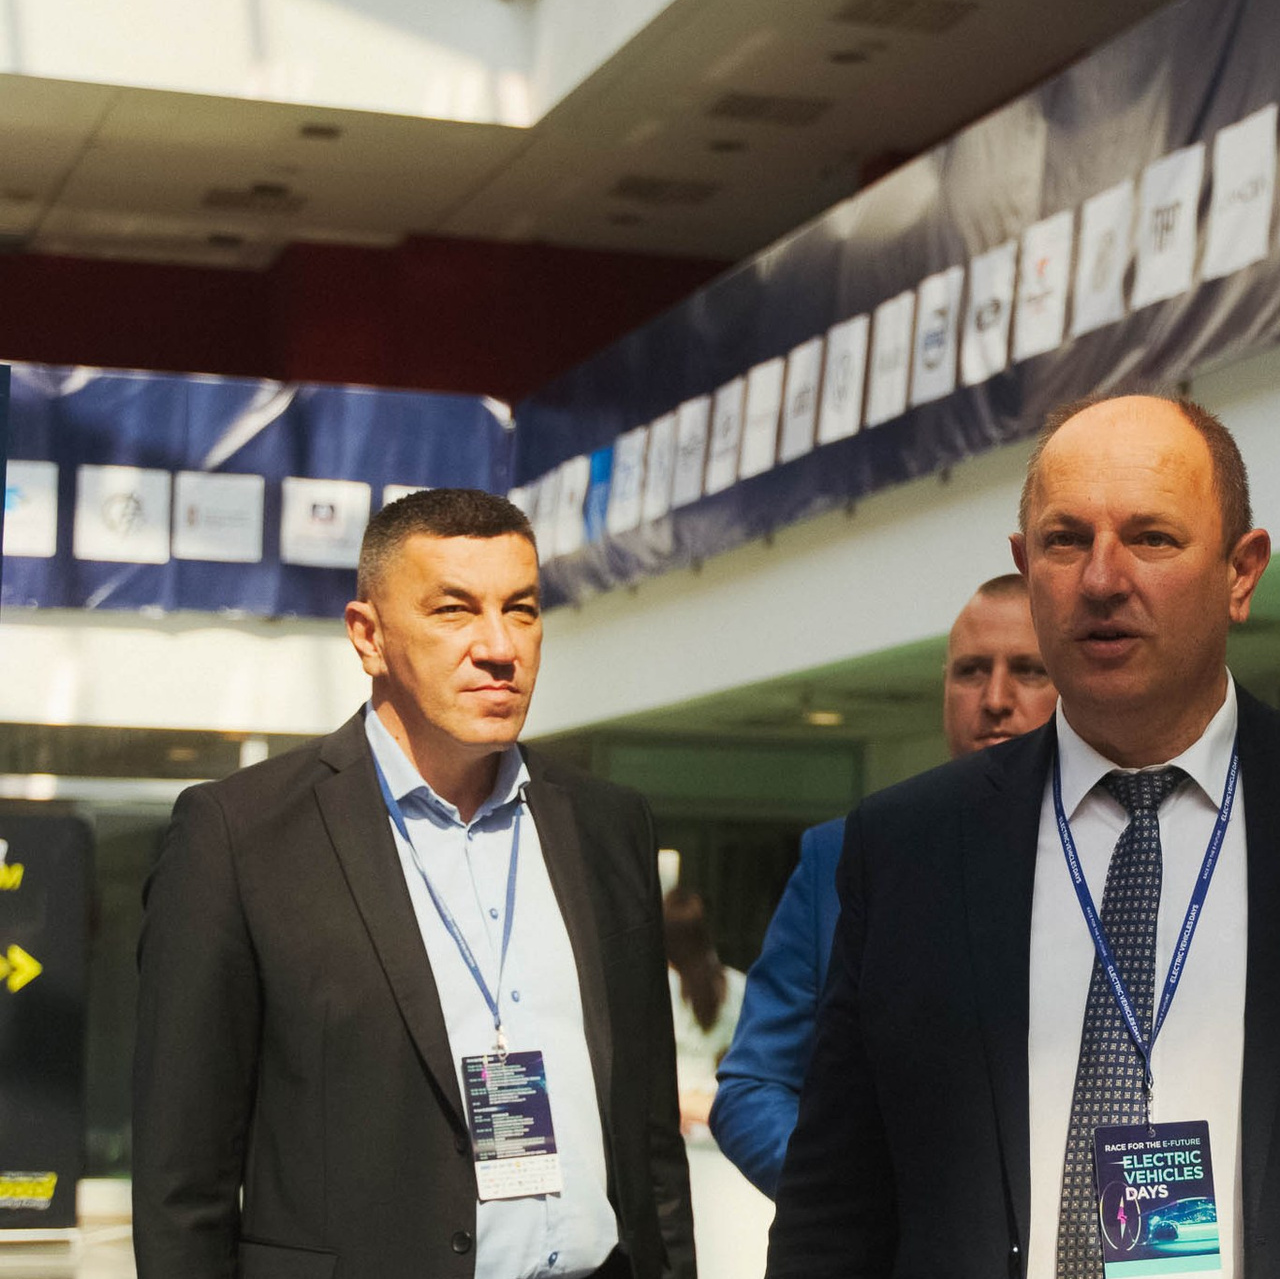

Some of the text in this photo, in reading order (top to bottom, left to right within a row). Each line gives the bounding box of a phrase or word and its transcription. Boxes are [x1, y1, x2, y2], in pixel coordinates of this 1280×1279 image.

[1168, 903, 1199, 984] ELECTRIC VEHICLES DAYS
[1105, 964, 1143, 1043] ELECTRIC VEHICLES DAYS
[1105, 1138, 1201, 1152] RACE FOR THE E-FUTURE
[1122, 1150, 1202, 1169] ELECTRIC
[1124, 1166, 1204, 1184] VEHICLES
[1125, 1184, 1169, 1200] DAYS
